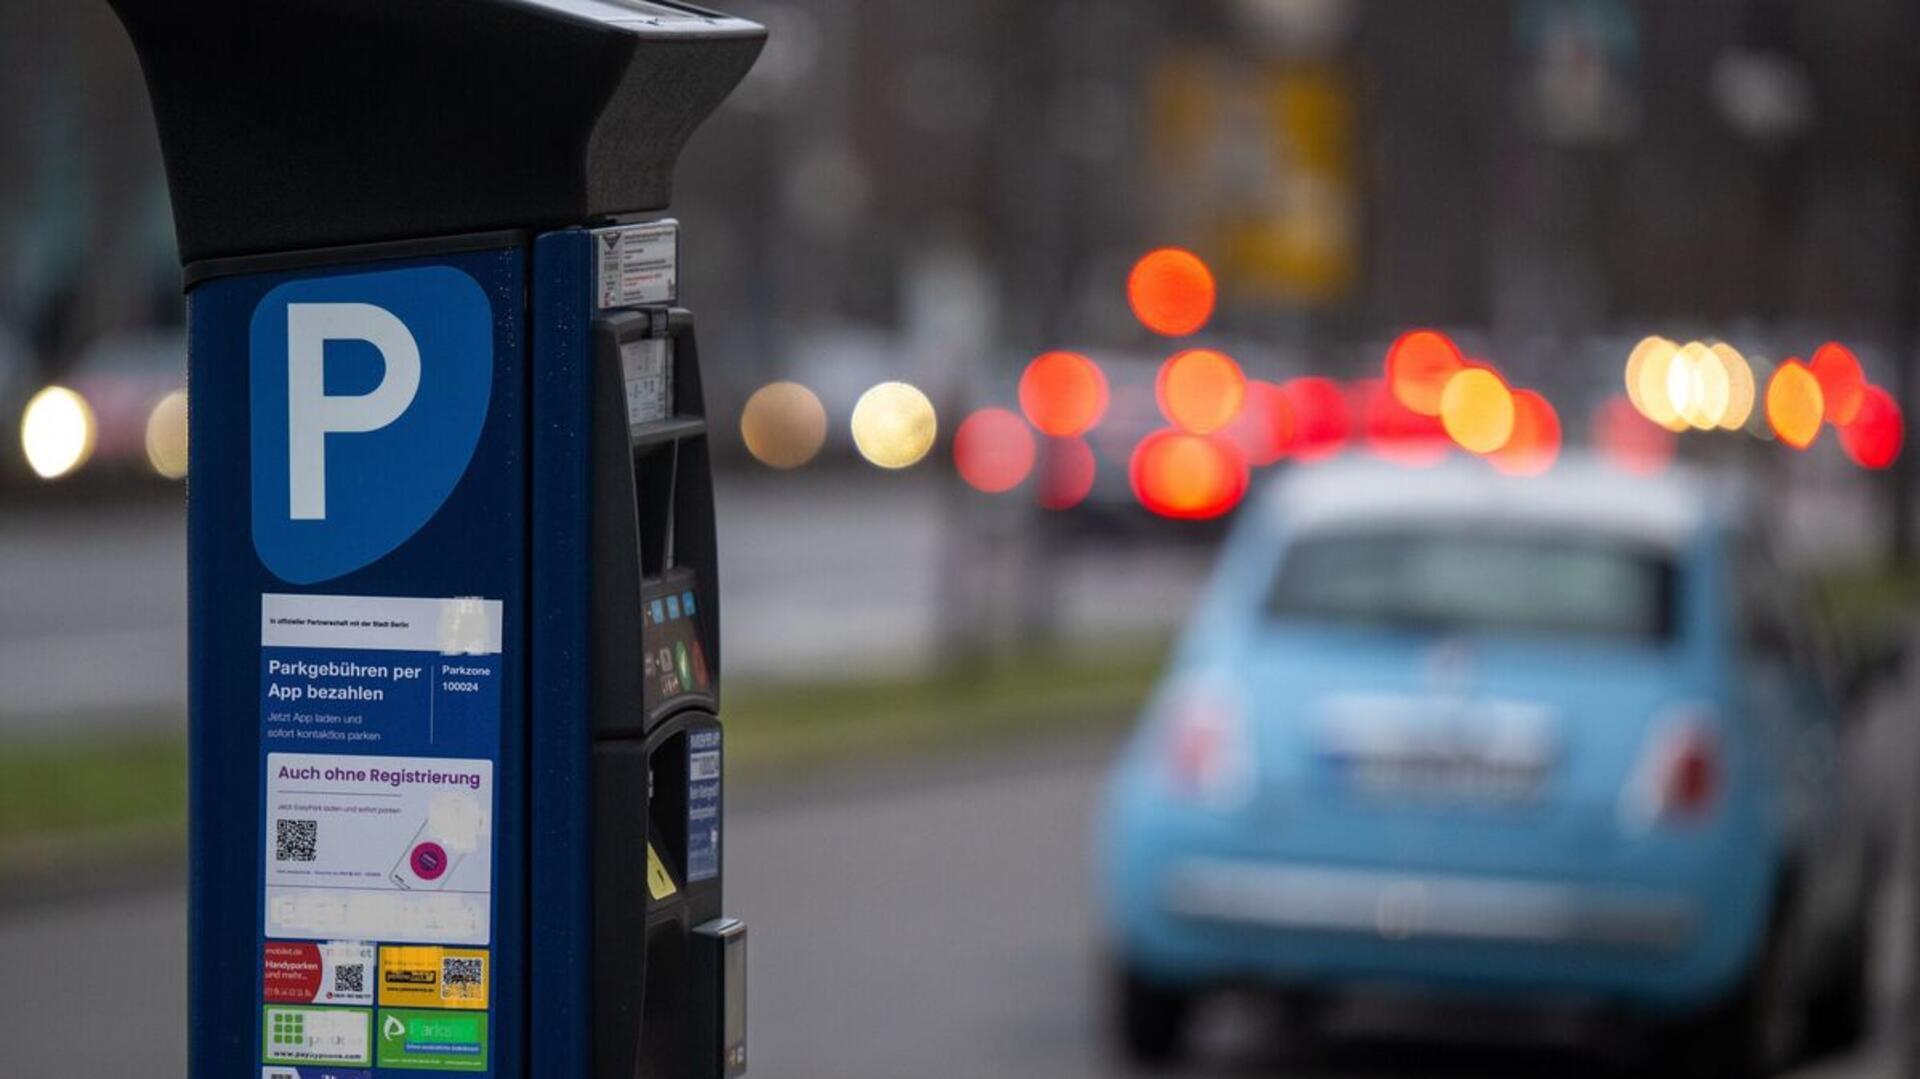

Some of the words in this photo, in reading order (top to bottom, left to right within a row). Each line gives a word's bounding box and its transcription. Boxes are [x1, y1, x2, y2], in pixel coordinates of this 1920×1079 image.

[287, 302, 422, 521] P
[268, 660, 388, 679] Parkgebühren
[393, 667, 422, 681] per
[442, 664, 491, 676] Parkzone
[268, 683, 302, 701] App
[307, 684, 384, 701] bezahlen
[443, 681, 479, 692] 100024
[267, 712, 291, 722] Jetzt
[293, 713, 313, 724] App
[315, 714, 342, 724] laden
[343, 715, 363, 724] und
[267, 729, 294, 738] sofort
[297, 730, 346, 740] kontaktlos
[347, 731, 381, 742] parken
[278, 766, 321, 780] Auch
[324, 767, 366, 782] ohne
[370, 768, 481, 790] Registrierung
[265, 960, 319, 971] Handyparken
